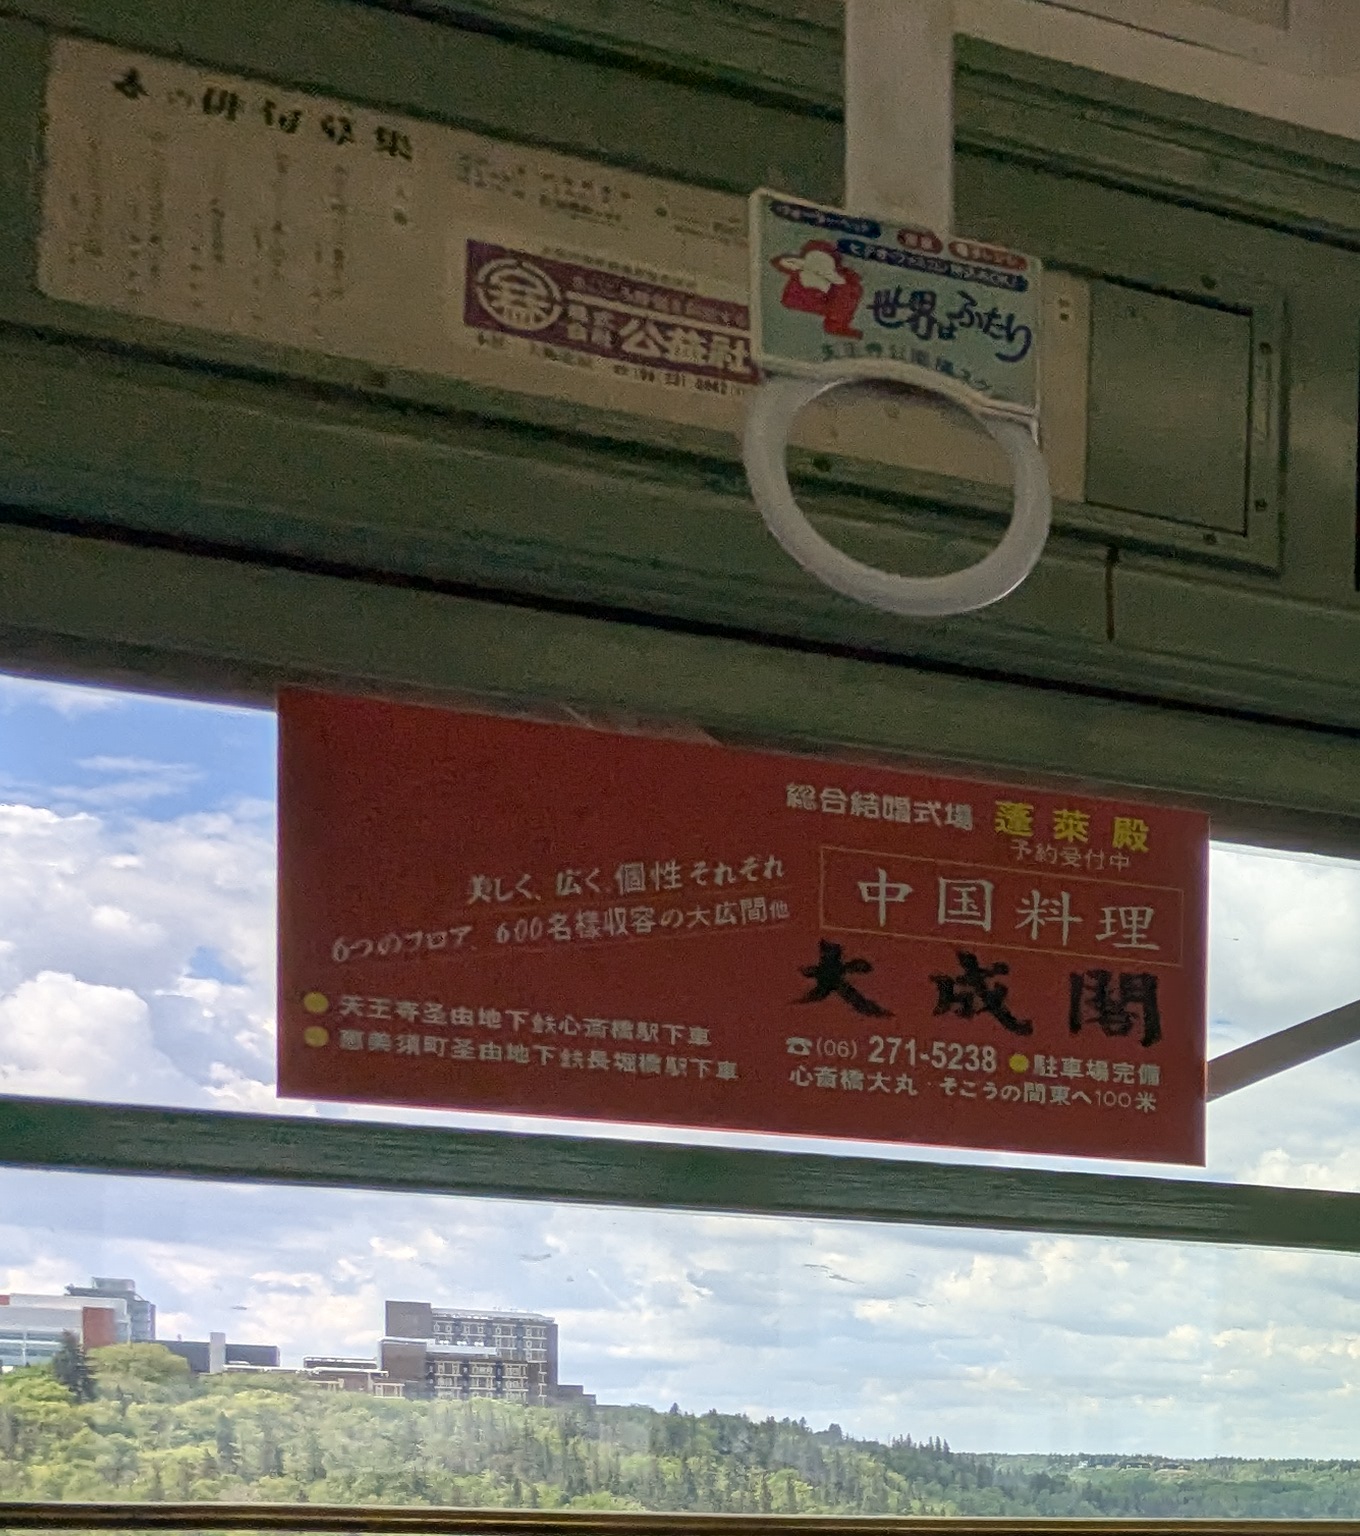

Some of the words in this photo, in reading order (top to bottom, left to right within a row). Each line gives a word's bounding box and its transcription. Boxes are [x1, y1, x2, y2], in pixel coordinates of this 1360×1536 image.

[785, 781, 974, 832] 総合結婚式場
[1010, 840, 1131, 872] 予約受付中
[856, 868, 1161, 951] 中国料理
[786, 937, 1162, 1048] 大成閣
[816, 1038, 858, 1061] (06)
[868, 1034, 997, 1073] 271-5238
[1033, 1053, 1161, 1087] 駐車場完備
